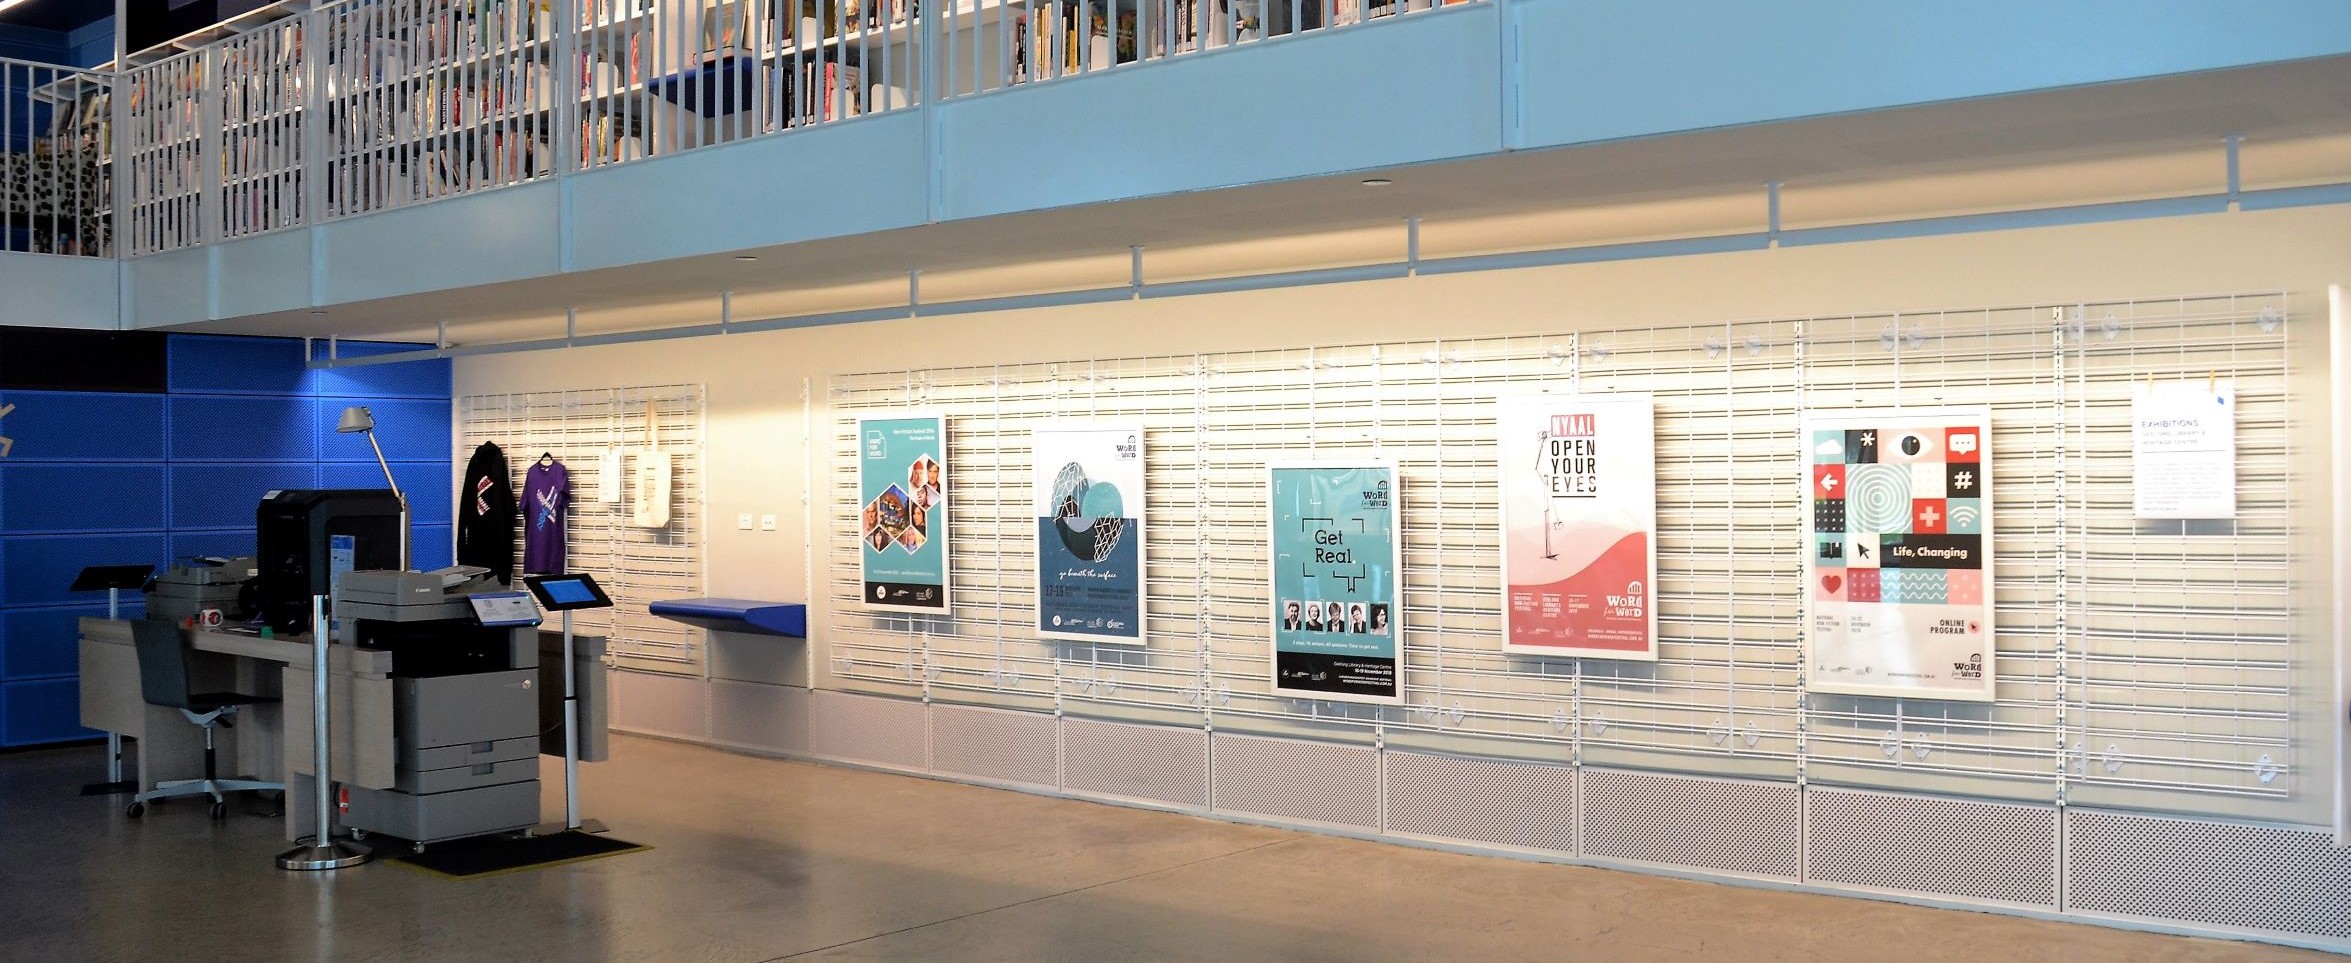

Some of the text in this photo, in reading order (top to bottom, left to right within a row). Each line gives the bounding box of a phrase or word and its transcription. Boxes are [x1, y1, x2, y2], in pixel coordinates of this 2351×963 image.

[1552, 415, 1594, 436] NYAAL
[2141, 420, 2199, 428] EXHIBITIONS
[1552, 440, 1595, 456] OPEN
[1552, 458, 1596, 474] YOUR
[1552, 476, 1596, 492] EYES
[1315, 530, 1343, 545] Get
[1316, 548, 1356, 564] Real.
[1893, 546, 1968, 560] Life, Changing
[1098, 570, 1117, 580] surface
